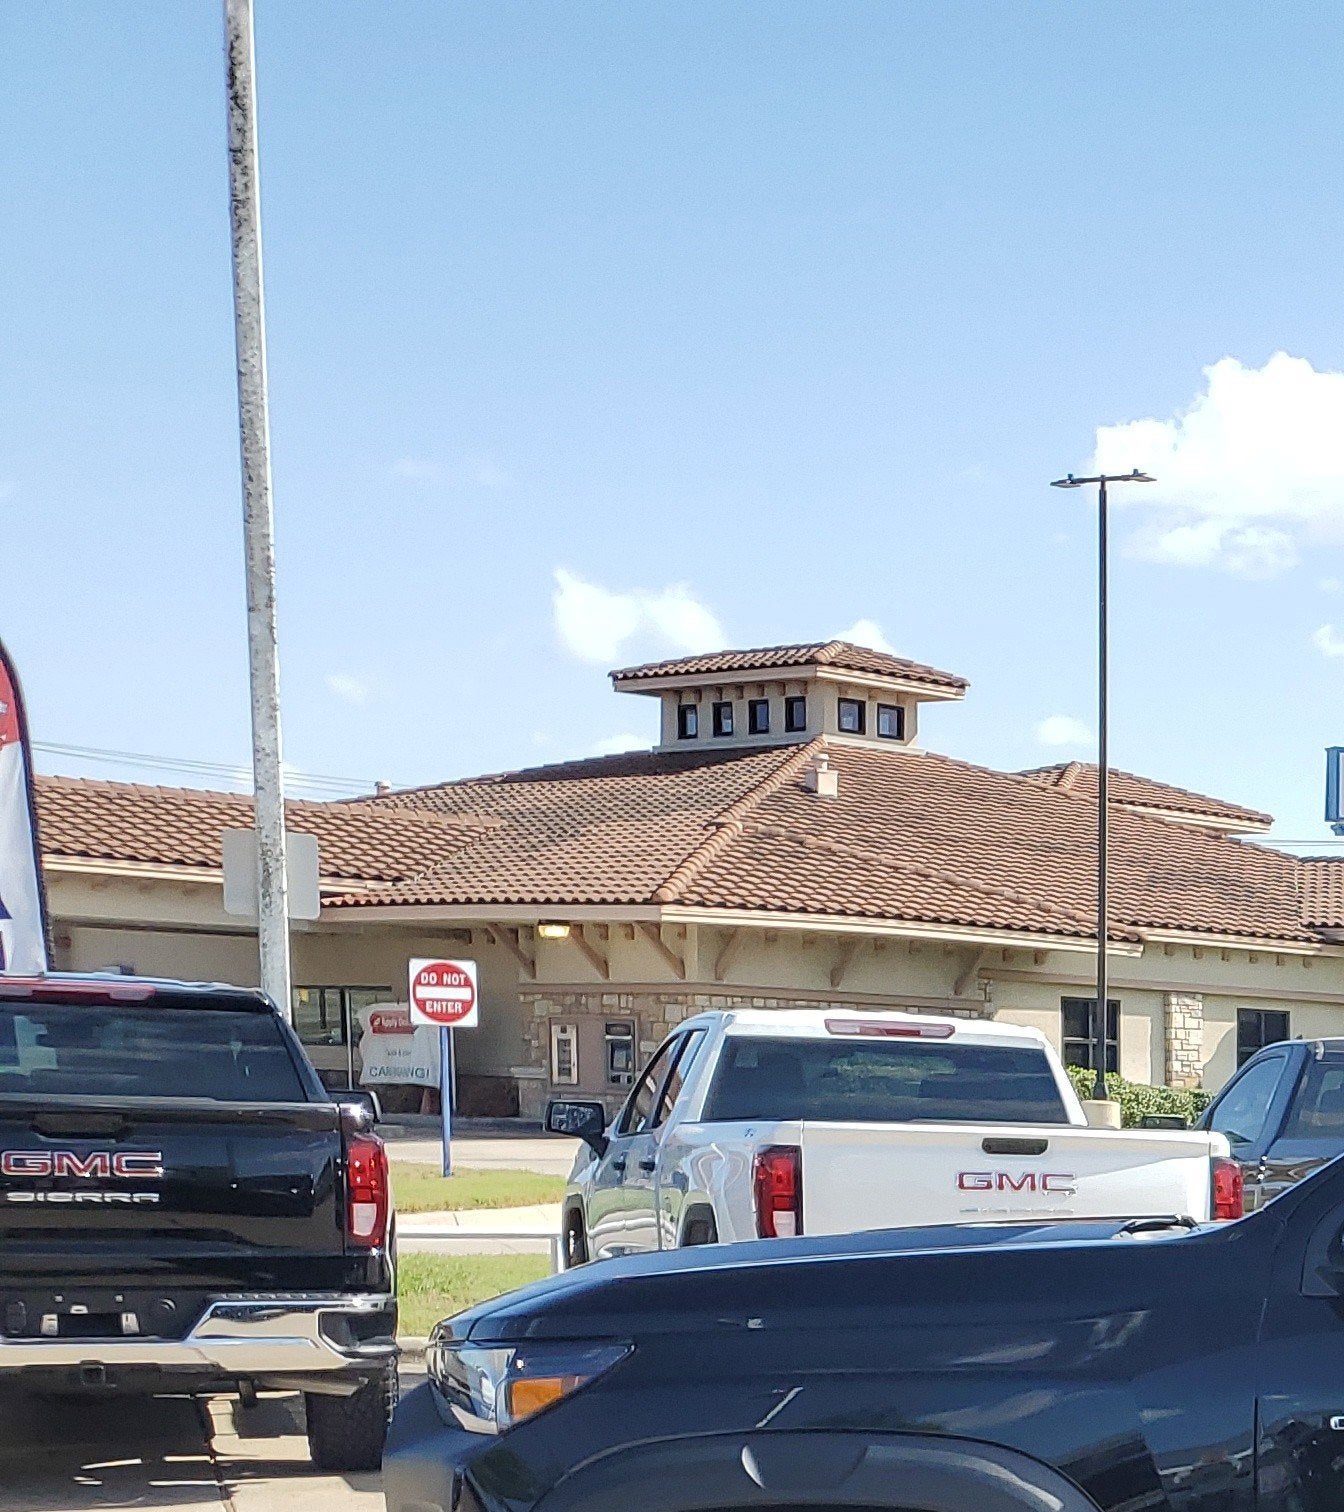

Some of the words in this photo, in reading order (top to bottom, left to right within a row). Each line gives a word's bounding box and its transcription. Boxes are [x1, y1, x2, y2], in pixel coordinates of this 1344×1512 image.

[420, 972, 437, 985] DO
[443, 972, 467, 985] NOT
[425, 1001, 463, 1014] ENTER
[1, 1150, 163, 1177] GMC
[957, 1172, 1077, 1194] GMC
[6, 1192, 160, 1203] SIERRA
